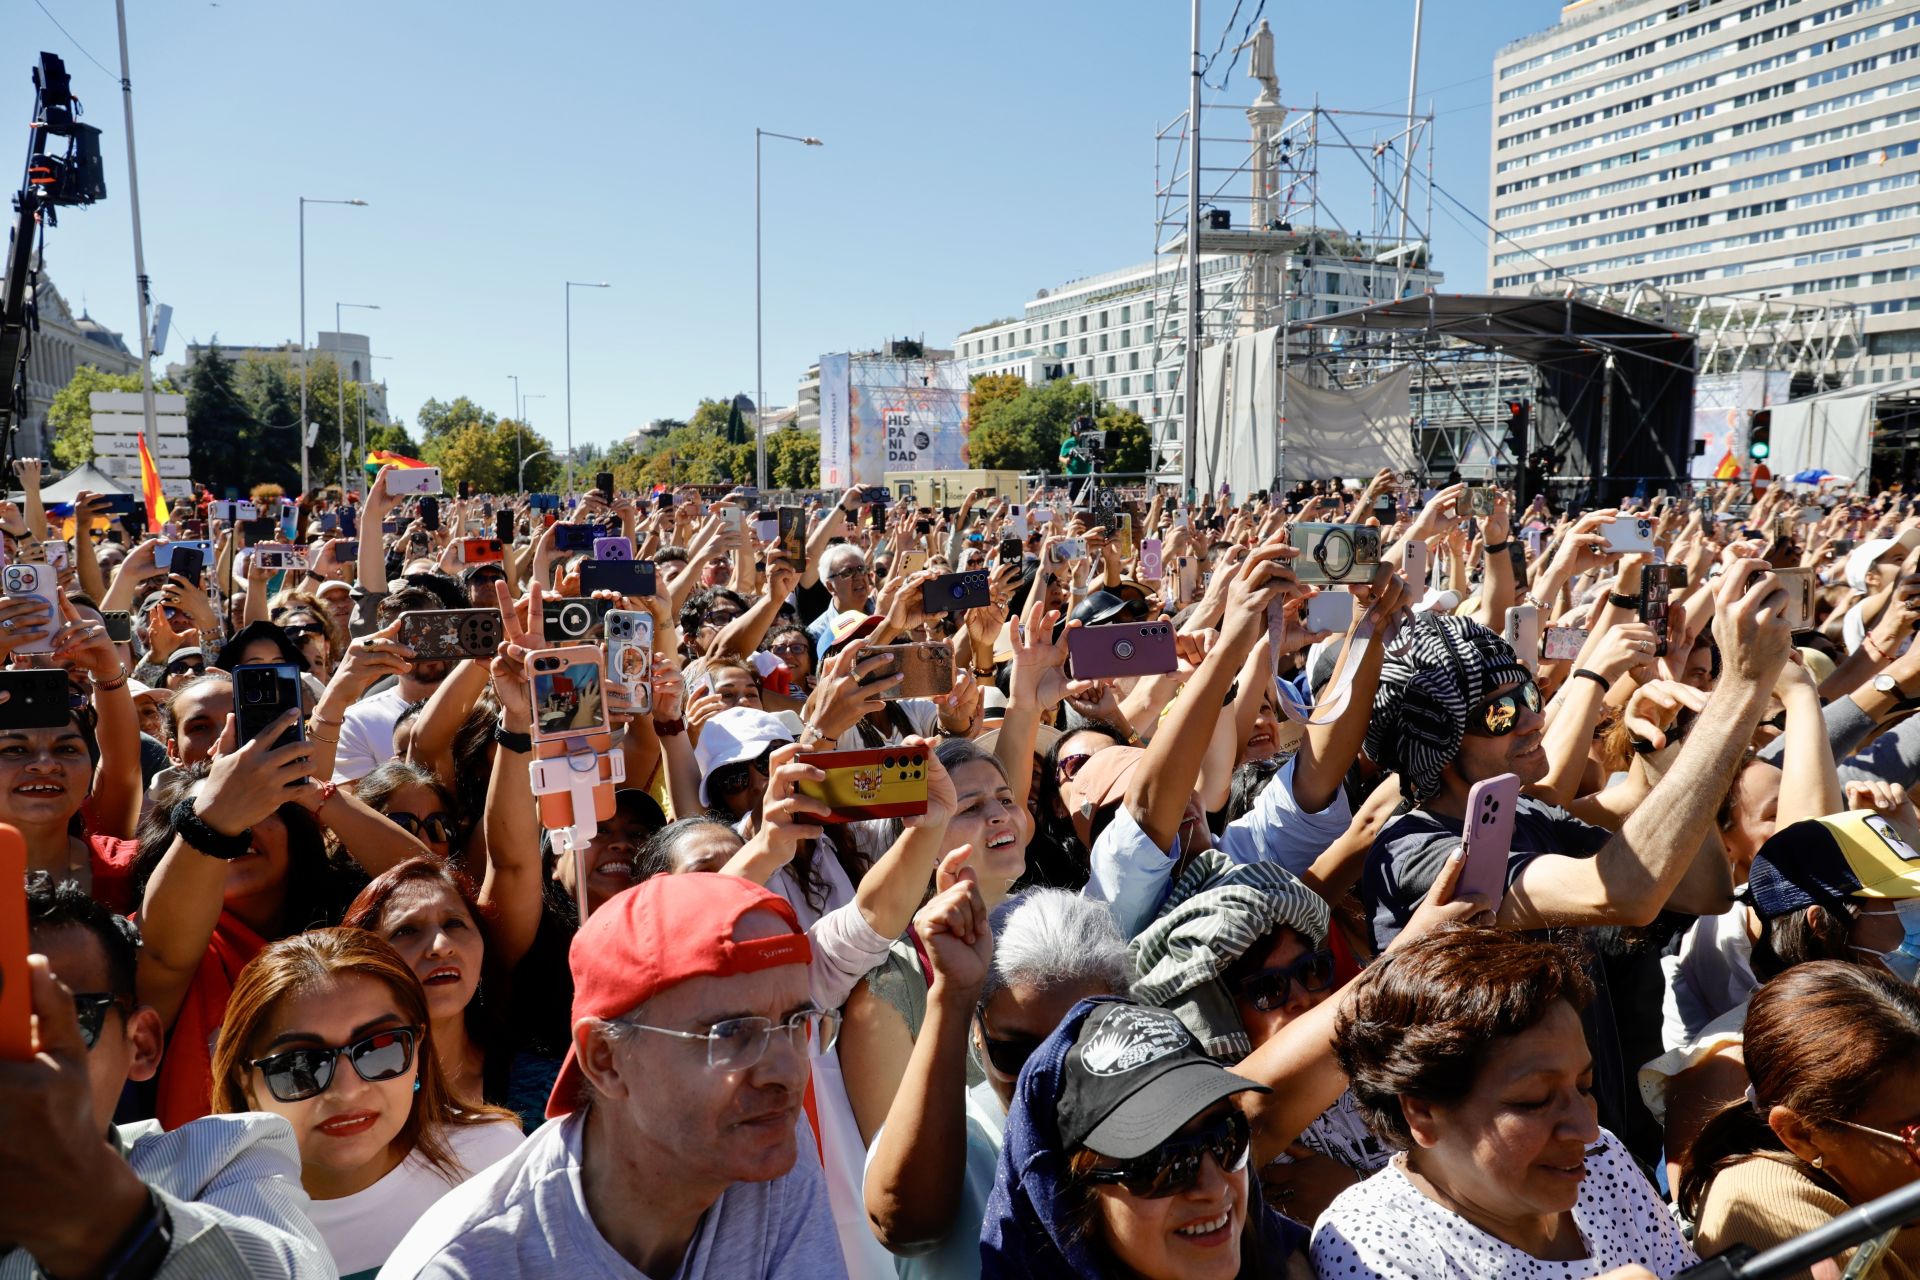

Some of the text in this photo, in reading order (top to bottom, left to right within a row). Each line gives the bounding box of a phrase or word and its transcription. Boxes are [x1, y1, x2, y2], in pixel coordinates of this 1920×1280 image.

[889, 415, 910, 426] HIS
[889, 427, 906, 438] PA
[889, 439, 902, 449] NI
[889, 451, 917, 461] DAD
